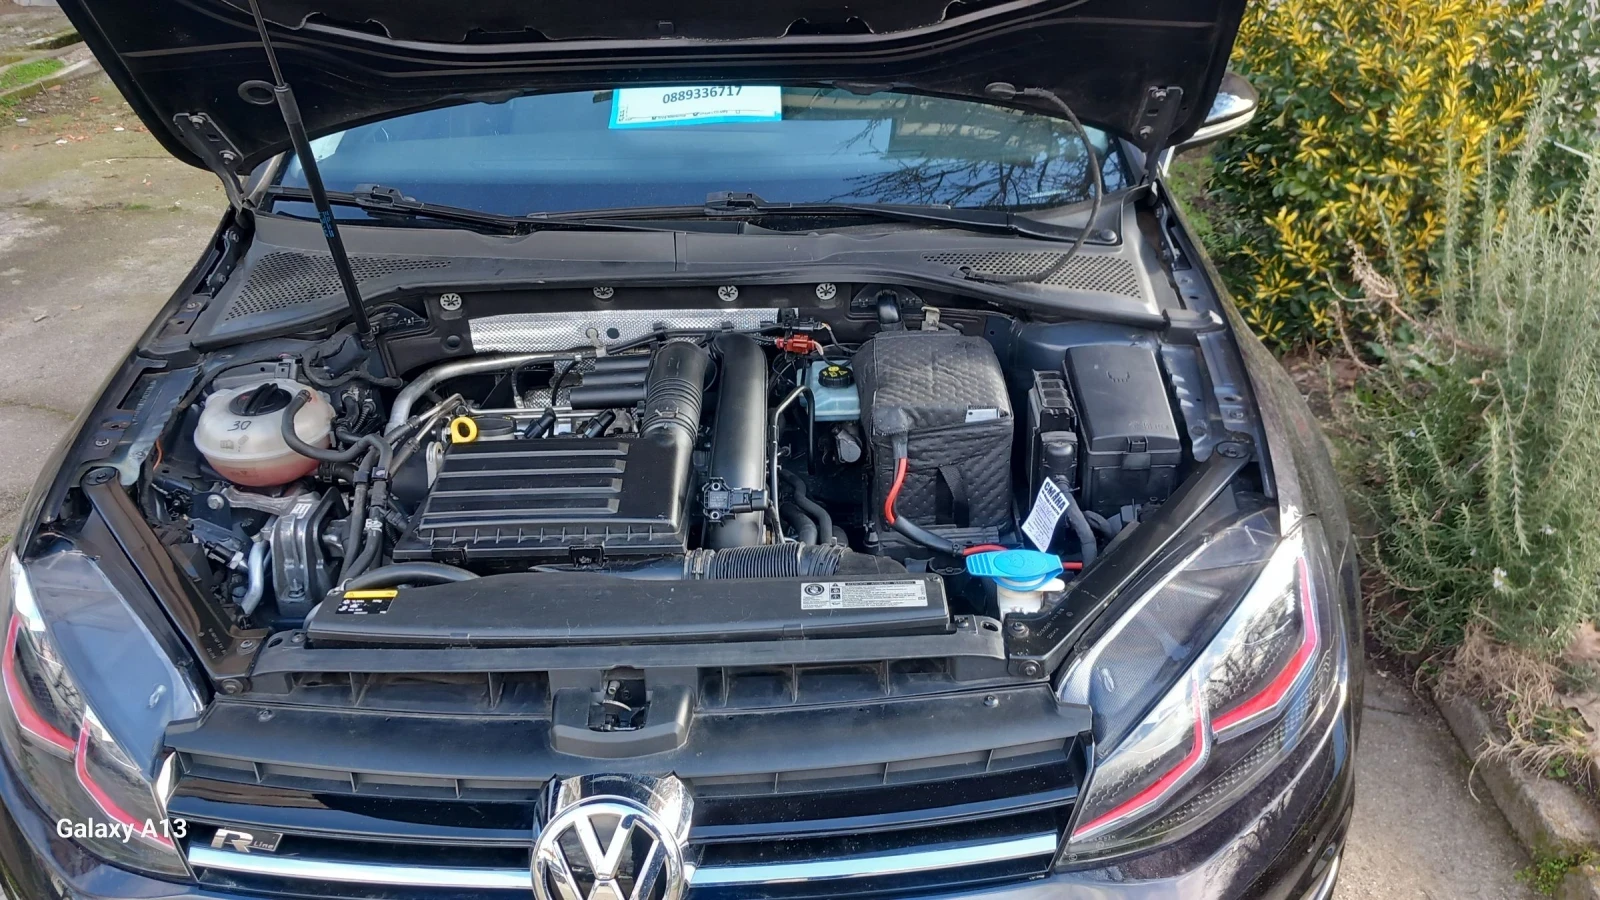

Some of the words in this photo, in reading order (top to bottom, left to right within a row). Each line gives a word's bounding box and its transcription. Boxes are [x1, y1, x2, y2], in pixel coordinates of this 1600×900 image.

[662, 85, 743, 104] 0889336717
[227, 420, 252, 432] 30
[211, 828, 254, 852] R
